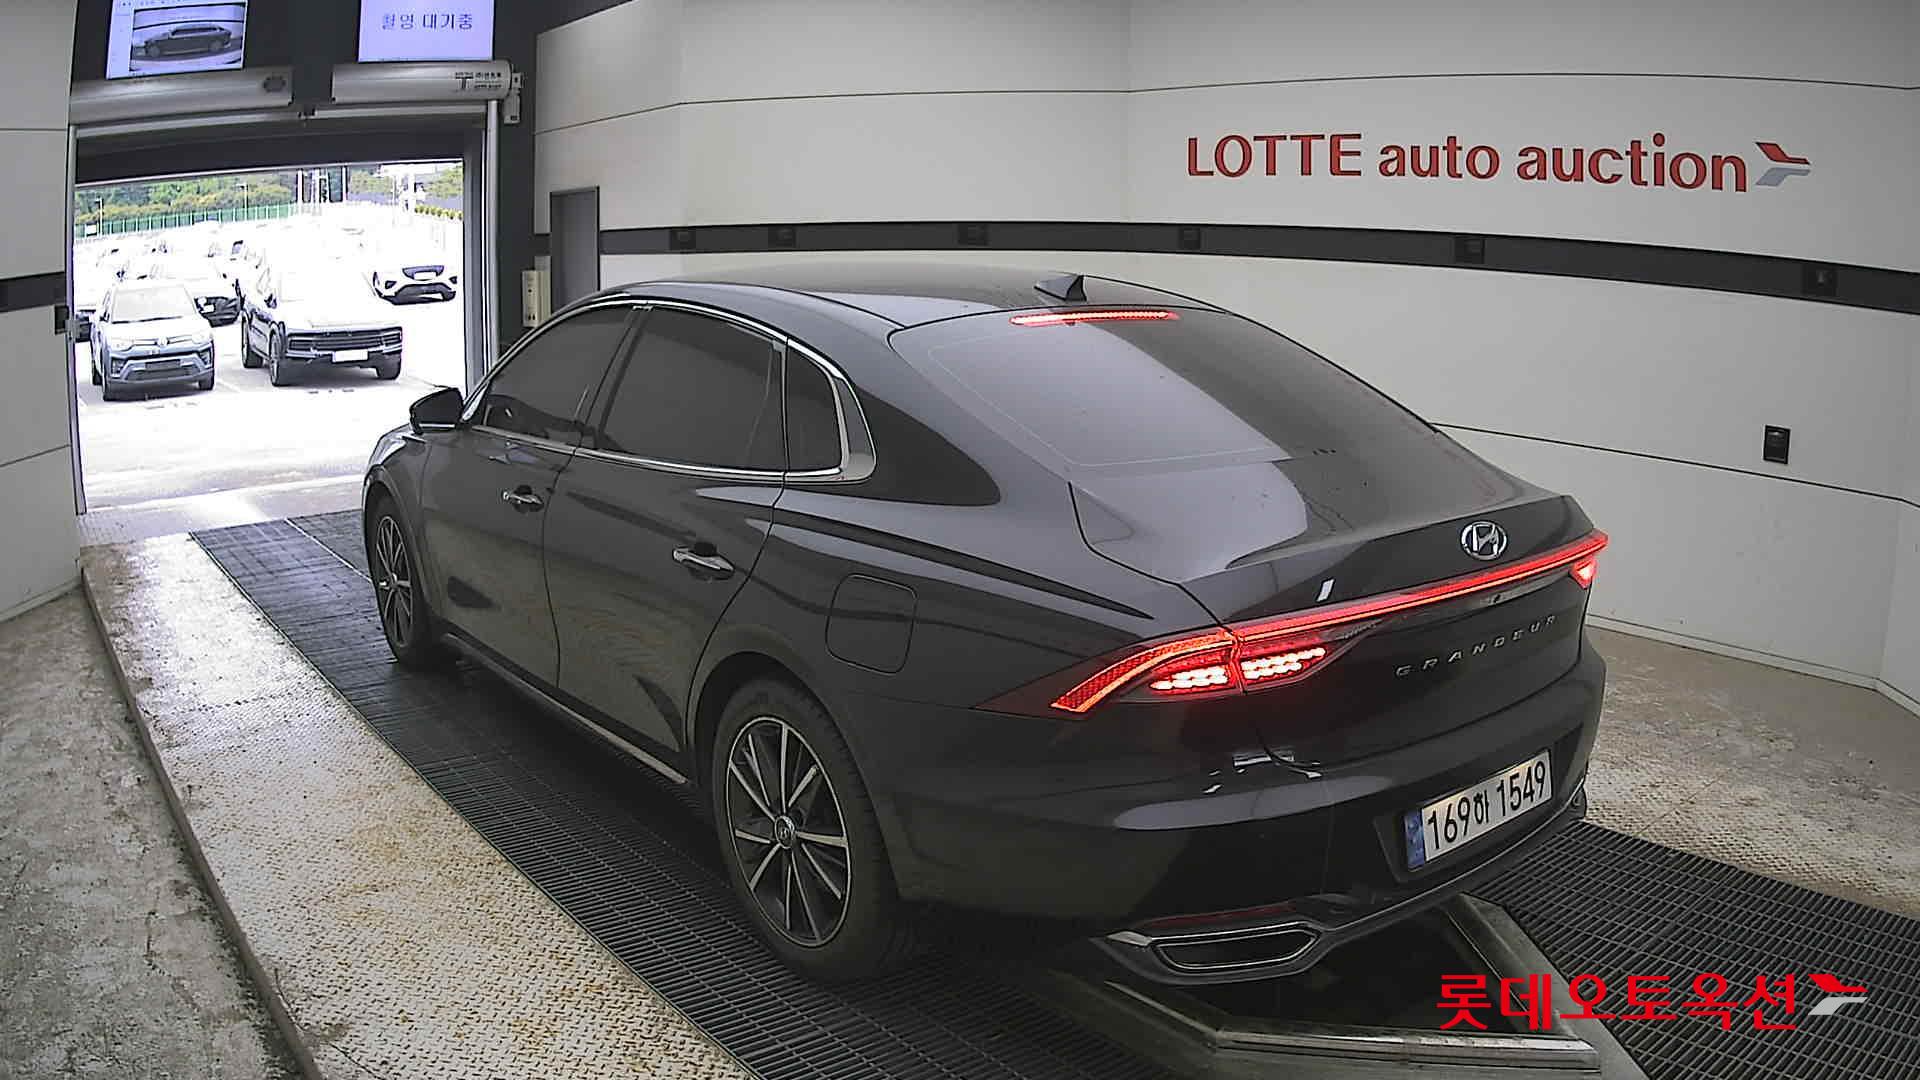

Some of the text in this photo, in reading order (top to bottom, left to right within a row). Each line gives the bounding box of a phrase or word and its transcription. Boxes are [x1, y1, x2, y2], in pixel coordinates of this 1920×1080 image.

[422, 13, 473, 30] 대기중
[1187, 132, 1748, 193] LOTTE auto auction
[1395, 614, 1556, 677] GRANDEUR
[1496, 760, 1546, 817] 1549
